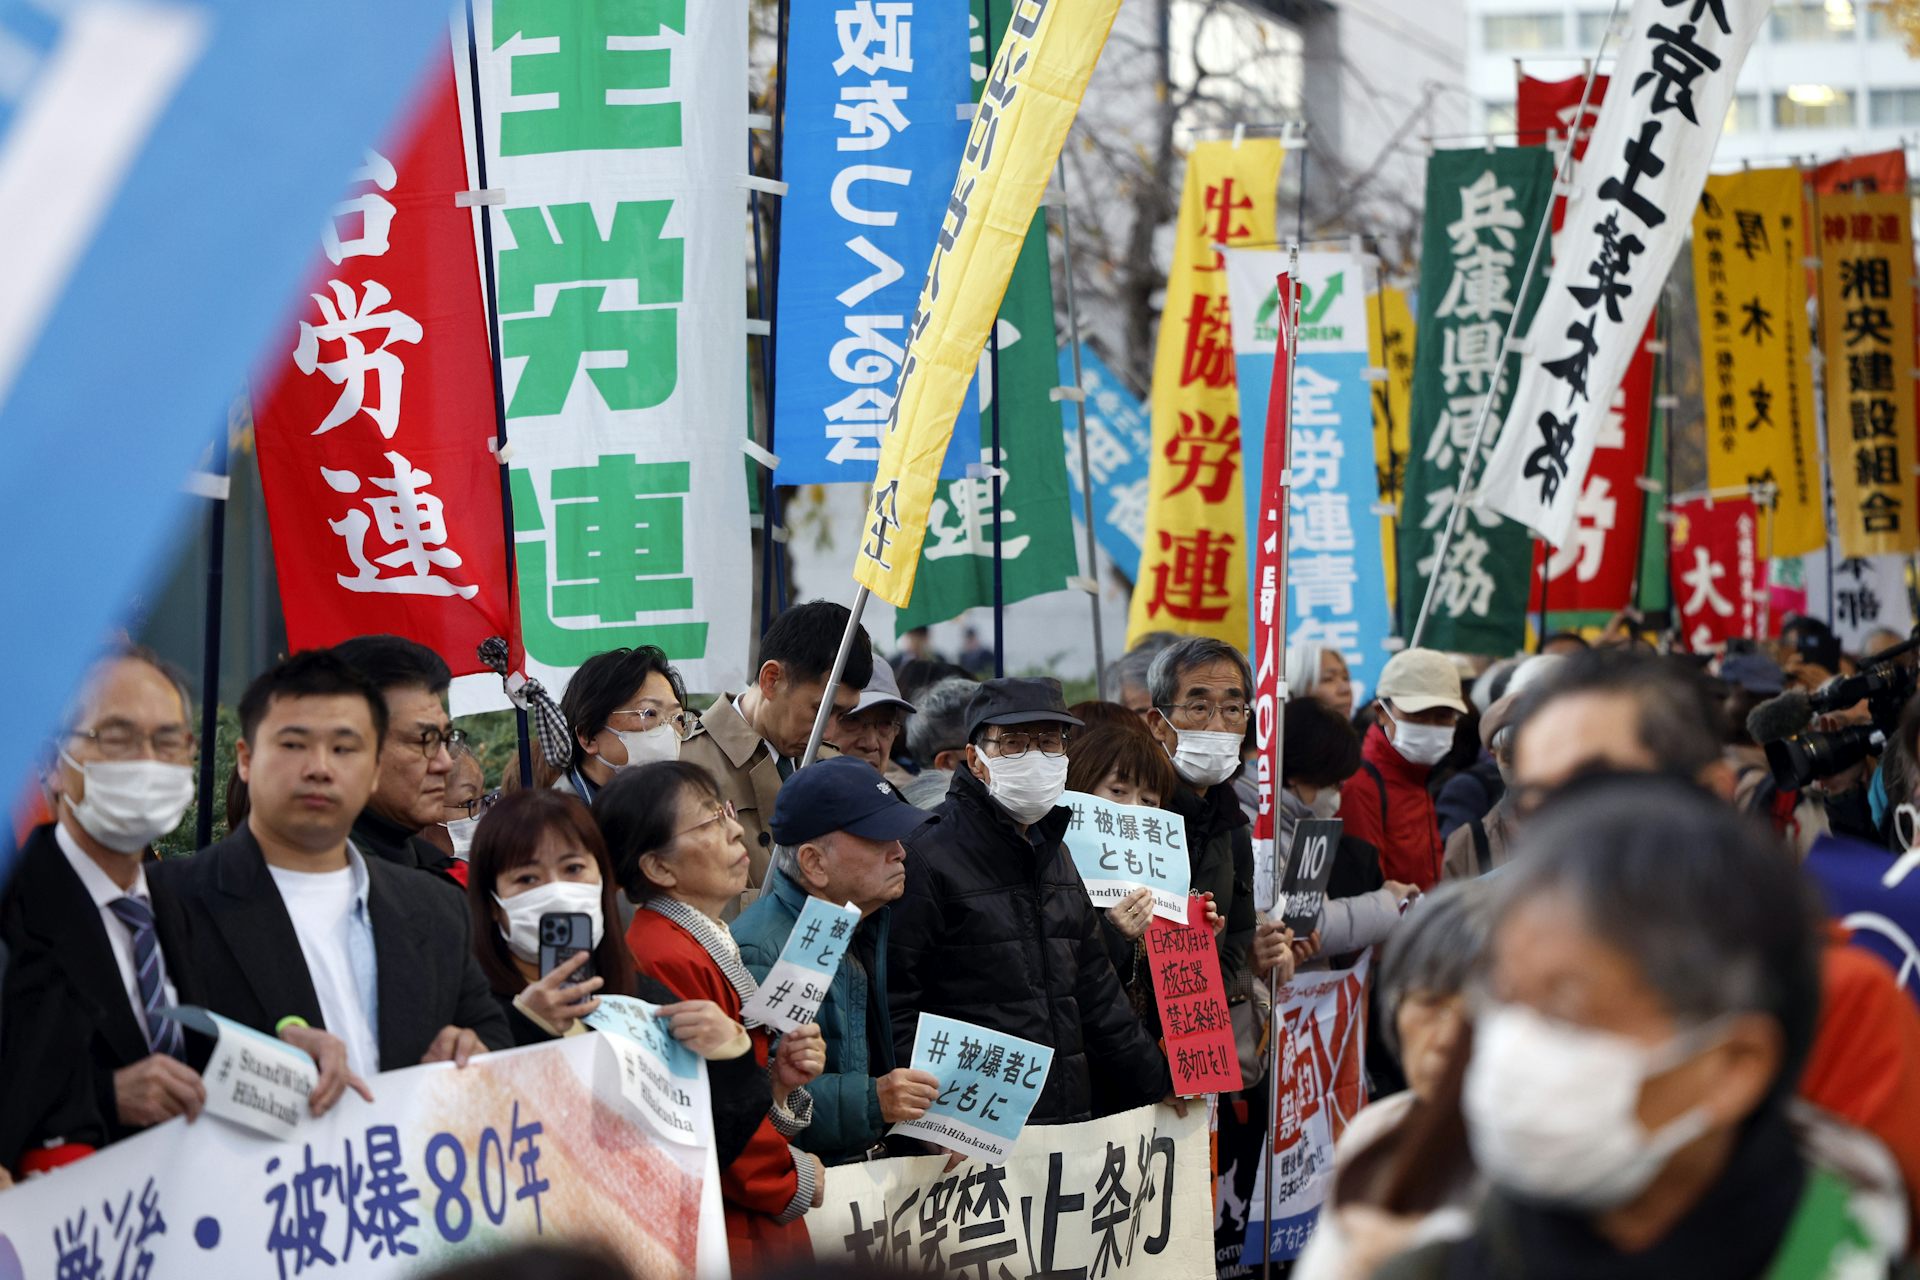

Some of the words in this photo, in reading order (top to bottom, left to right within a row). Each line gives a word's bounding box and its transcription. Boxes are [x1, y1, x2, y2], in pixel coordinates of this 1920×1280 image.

[492, 0, 708, 667] 全労連
[1146, 178, 1253, 623] 生協労連
[1840, 257, 1903, 534] 湘央建設組合
[1099, 842, 1167, 880] ともに
[1296, 835, 1327, 880] NO
[1160, 959, 1209, 996] 核兵器
[1166, 997, 1231, 1036] 禁止条約に
[935, 1079, 1009, 1122] ともに
